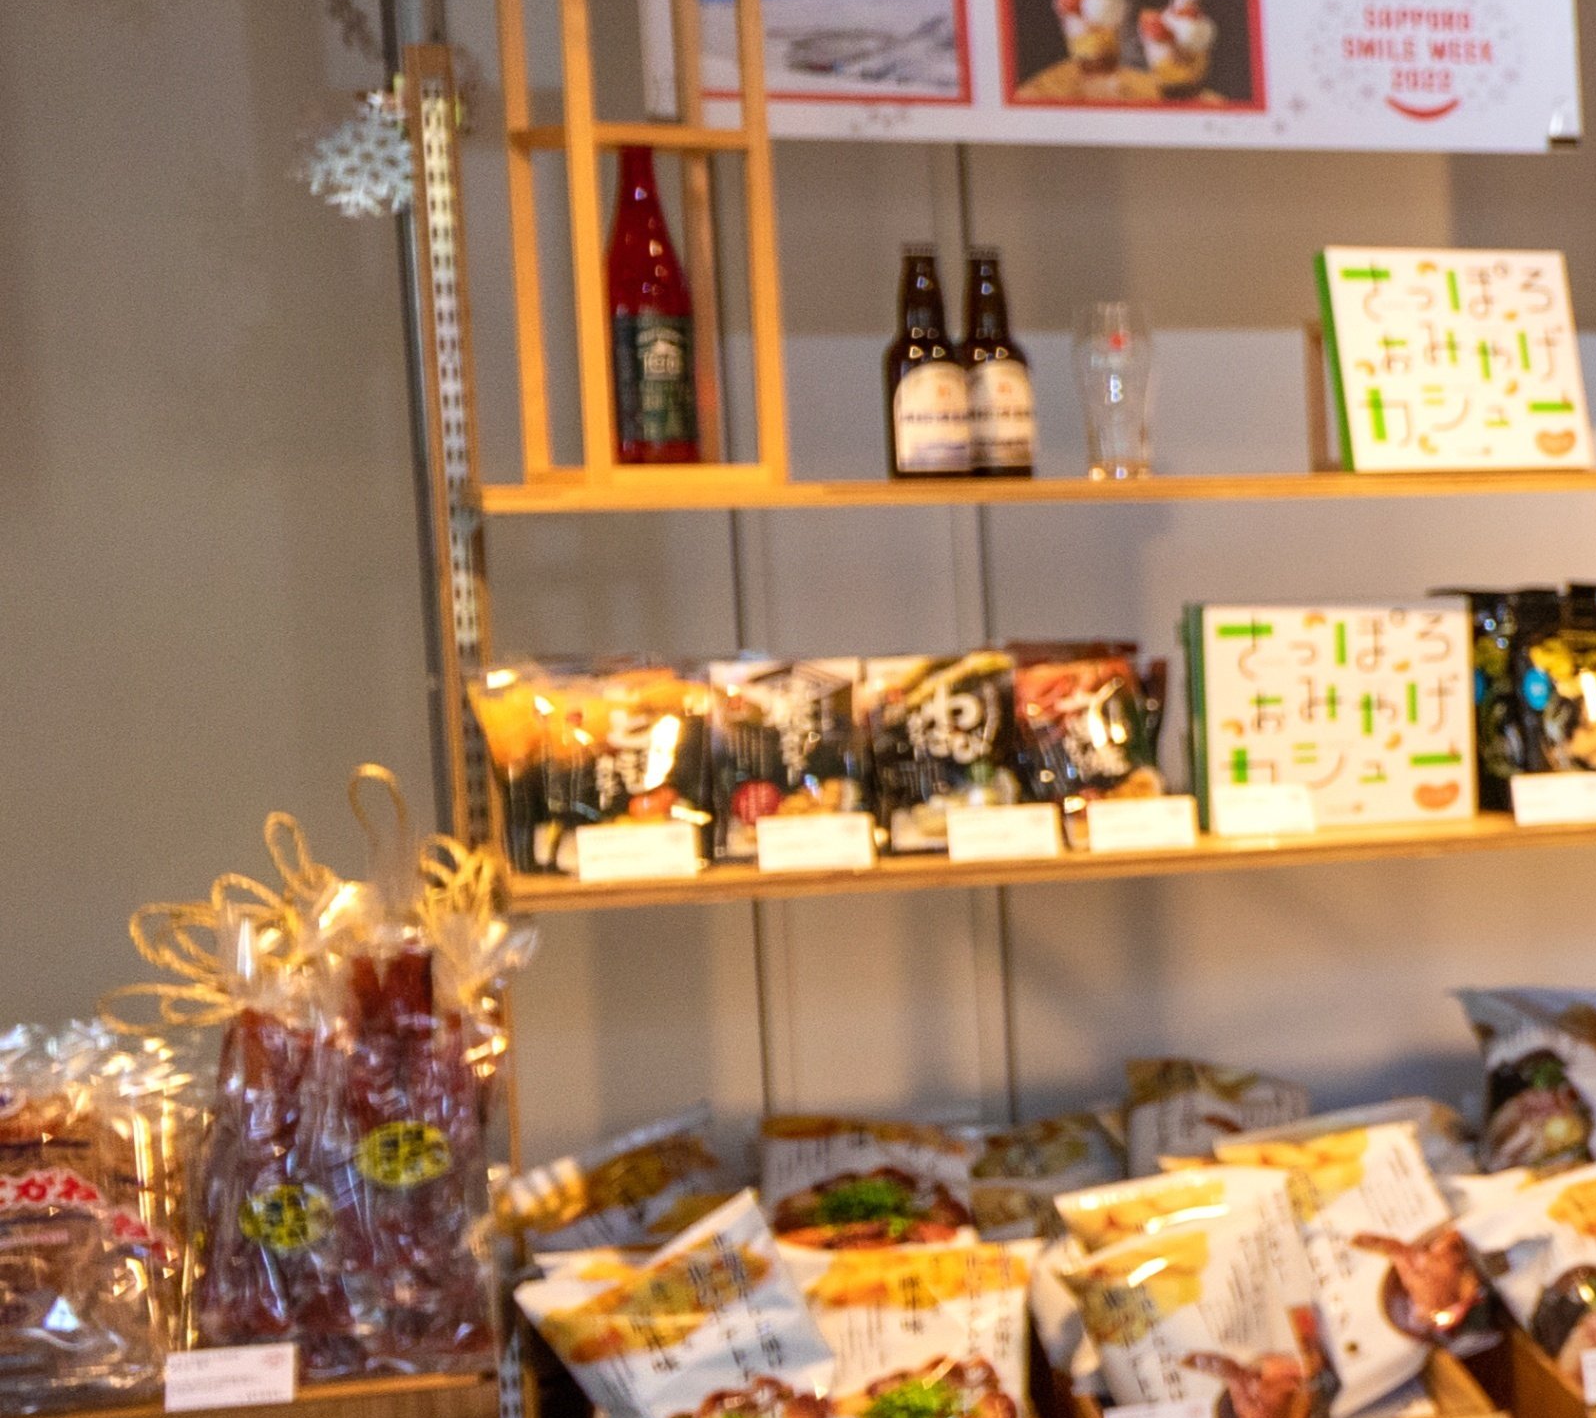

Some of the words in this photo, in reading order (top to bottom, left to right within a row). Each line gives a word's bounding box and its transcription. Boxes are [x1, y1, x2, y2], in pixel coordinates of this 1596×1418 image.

[1362, 5, 1471, 33] SAPPORO
[1341, 37, 1418, 62] SMILE
[1427, 40, 1495, 65] WEEK
